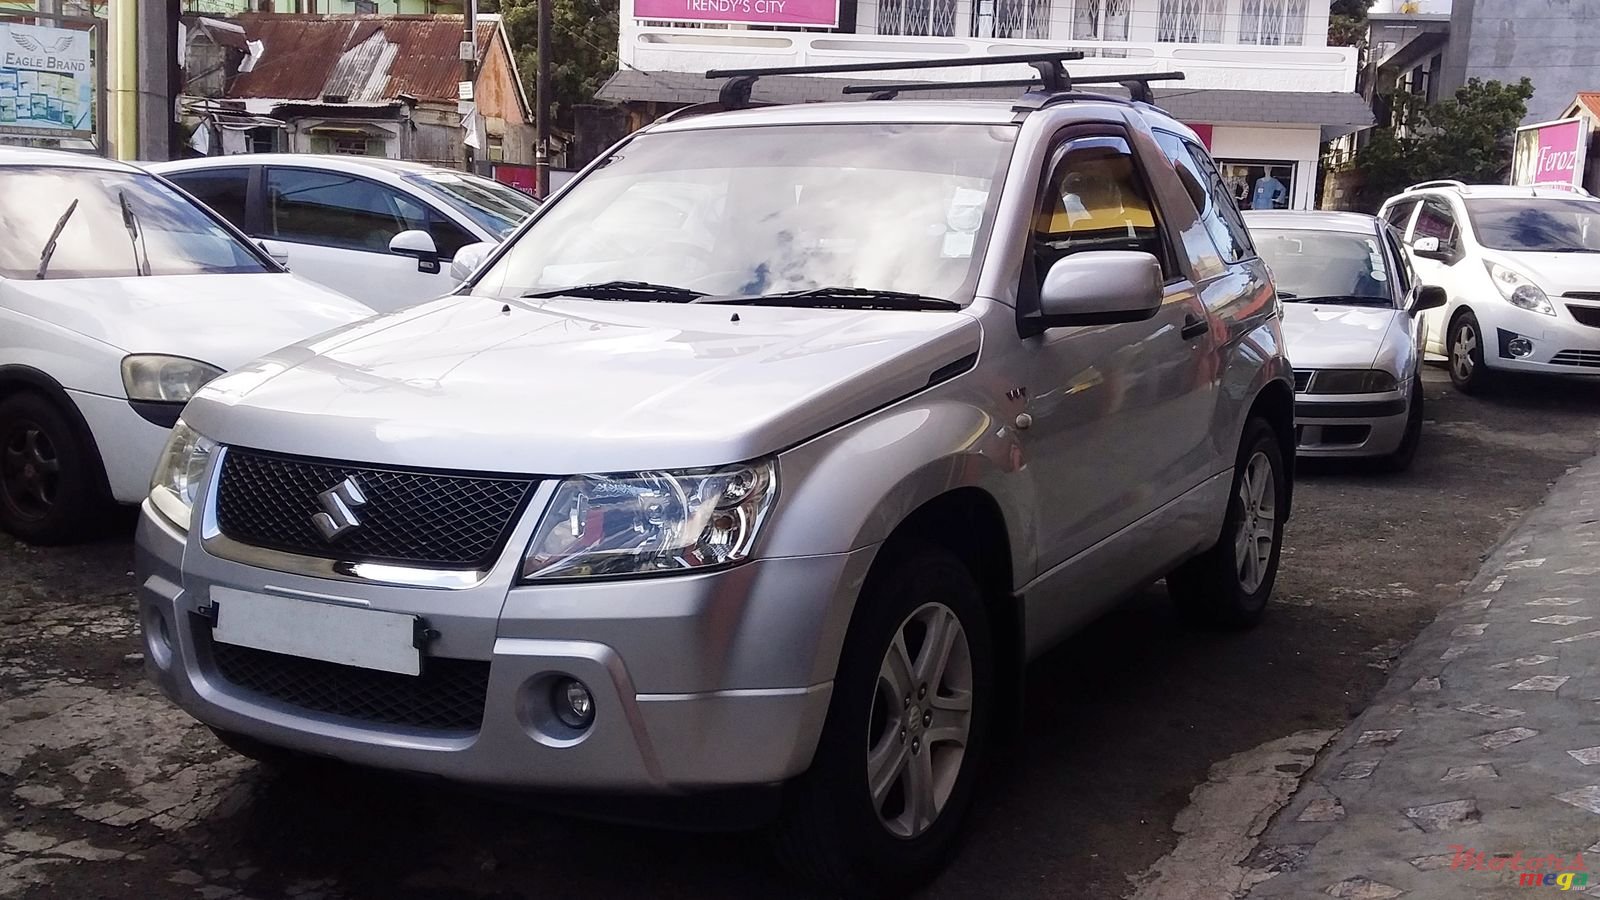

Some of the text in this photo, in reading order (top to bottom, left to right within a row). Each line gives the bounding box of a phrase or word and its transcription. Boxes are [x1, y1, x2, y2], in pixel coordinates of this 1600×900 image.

[754, 0, 786, 13] CITY
[5, 52, 85, 71] EAGLE BRAND
